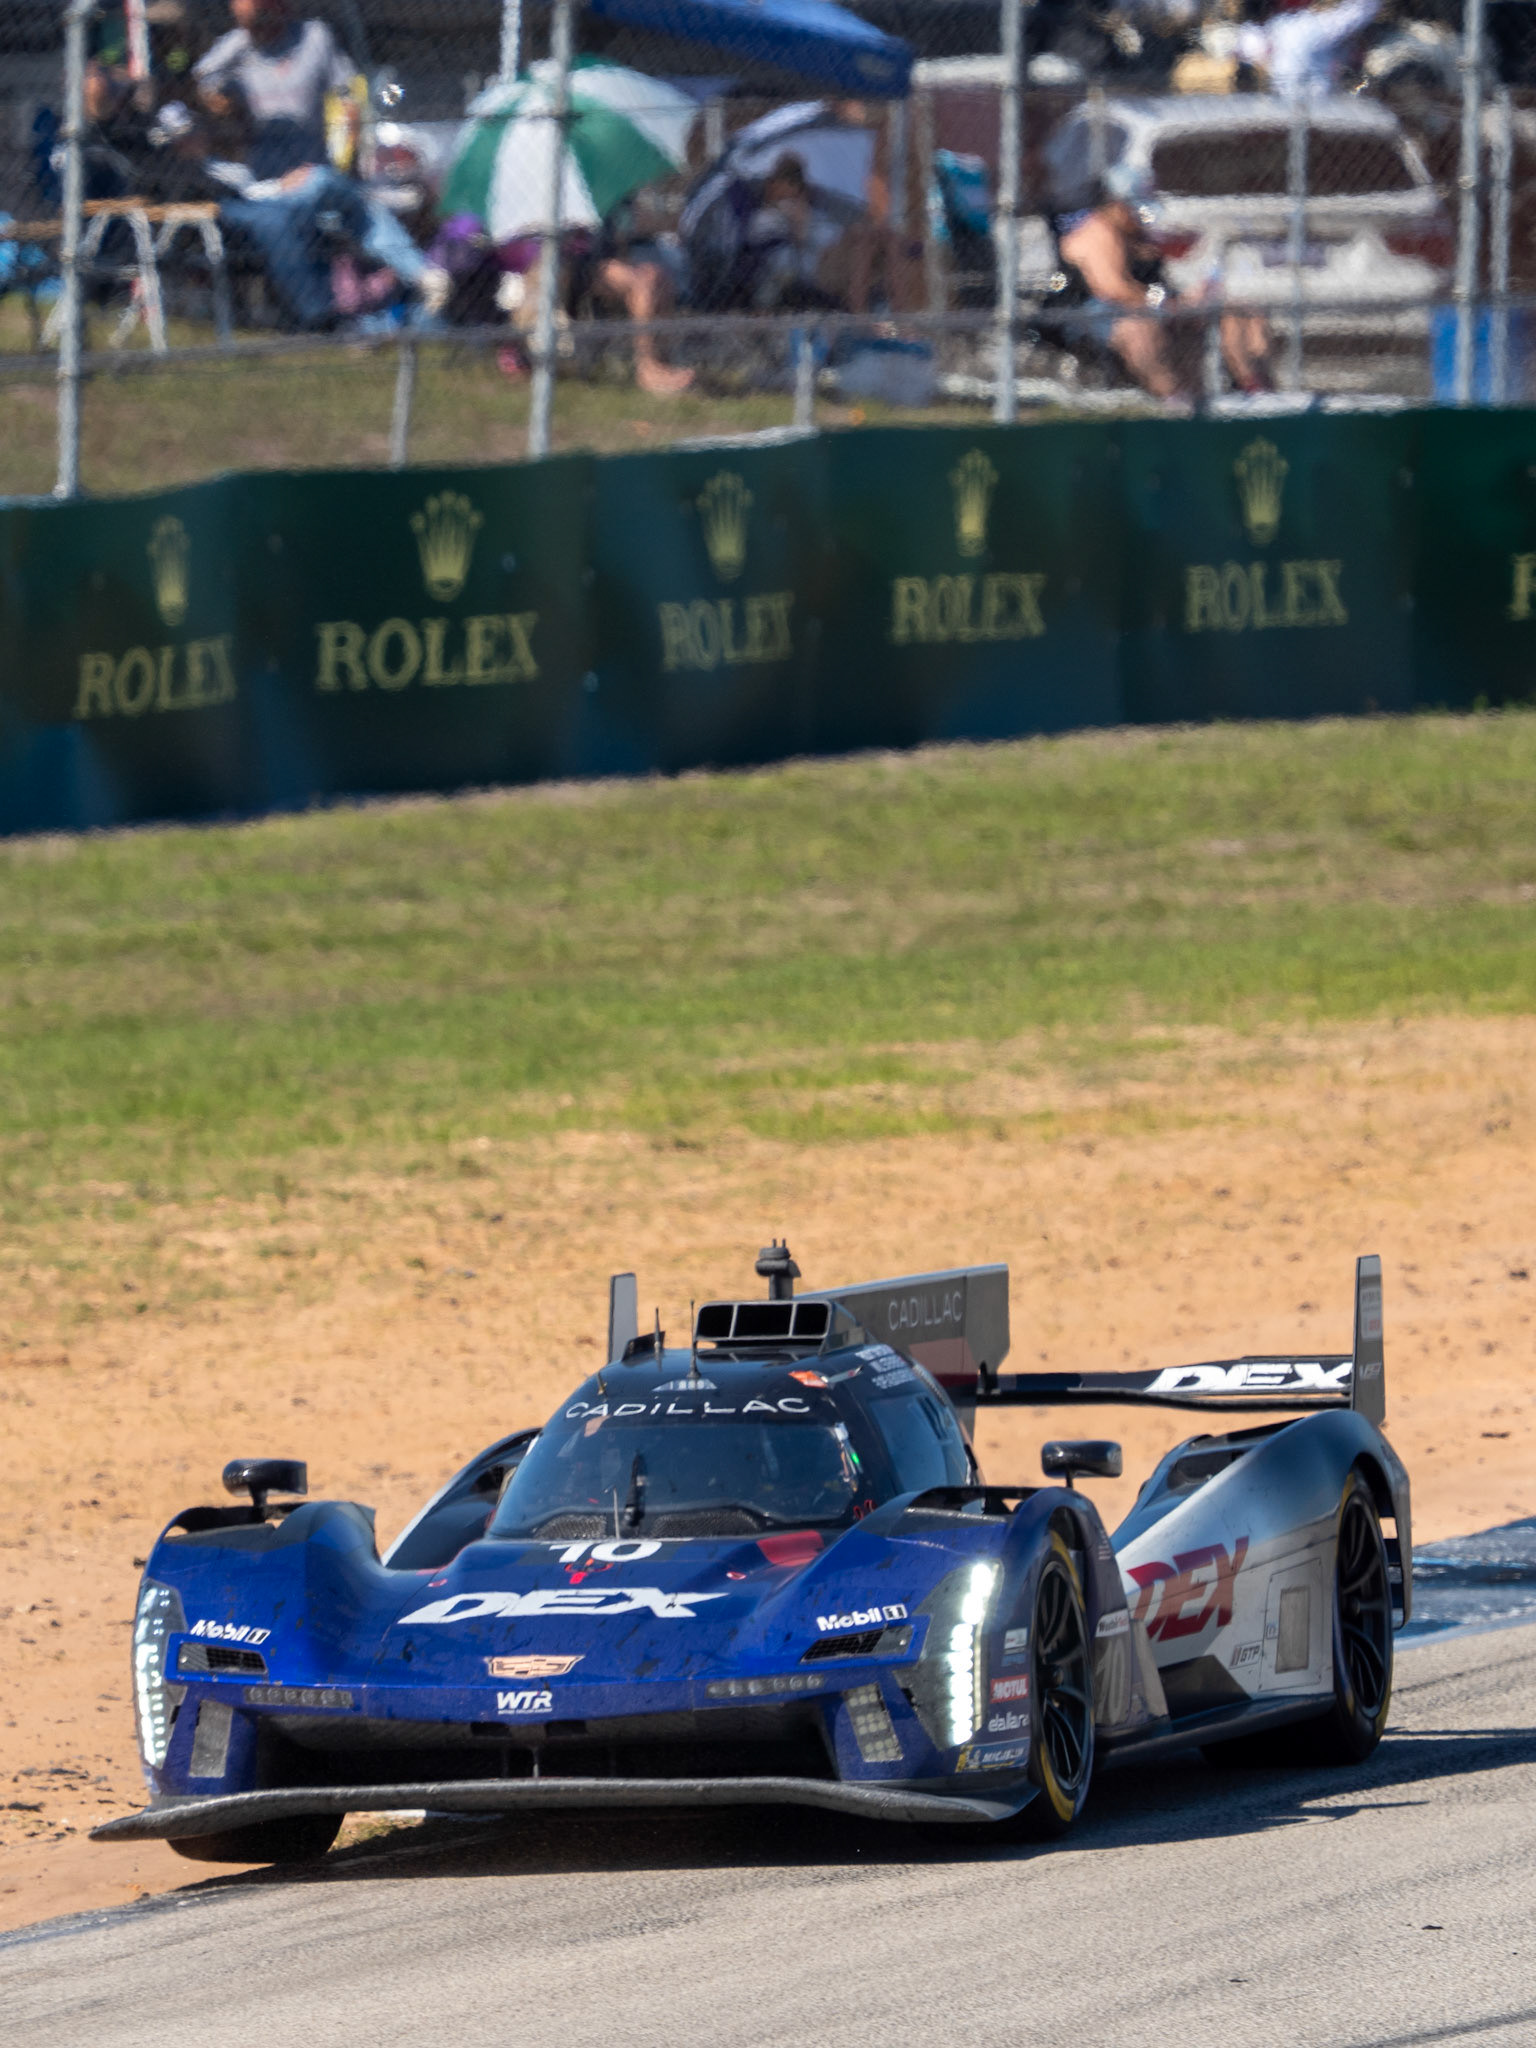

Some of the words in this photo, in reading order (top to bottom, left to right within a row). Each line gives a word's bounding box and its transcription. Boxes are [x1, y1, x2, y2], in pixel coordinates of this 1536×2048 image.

[891, 574, 1047, 644] ROLEX
[1184, 561, 1347, 632] ROLEX
[658, 591, 794, 671] ROLEX
[316, 612, 538, 691] ROLEX
[74, 634, 237, 719] ROLEX
[888, 1291, 962, 1331] CADILLAC
[1144, 1362, 1353, 1392] DEX
[566, 1398, 810, 1418] CADILLAC
[549, 1541, 662, 1563] 10
[397, 1587, 730, 1623] DEX
[1126, 1536, 1249, 1642] DEX
[190, 1619, 251, 1642] Mobil
[816, 1607, 882, 1631] Mobil
[497, 1690, 553, 1709] WTR
[993, 1678, 1028, 1699] MOTUL
[1095, 1638, 1126, 1726] 10
